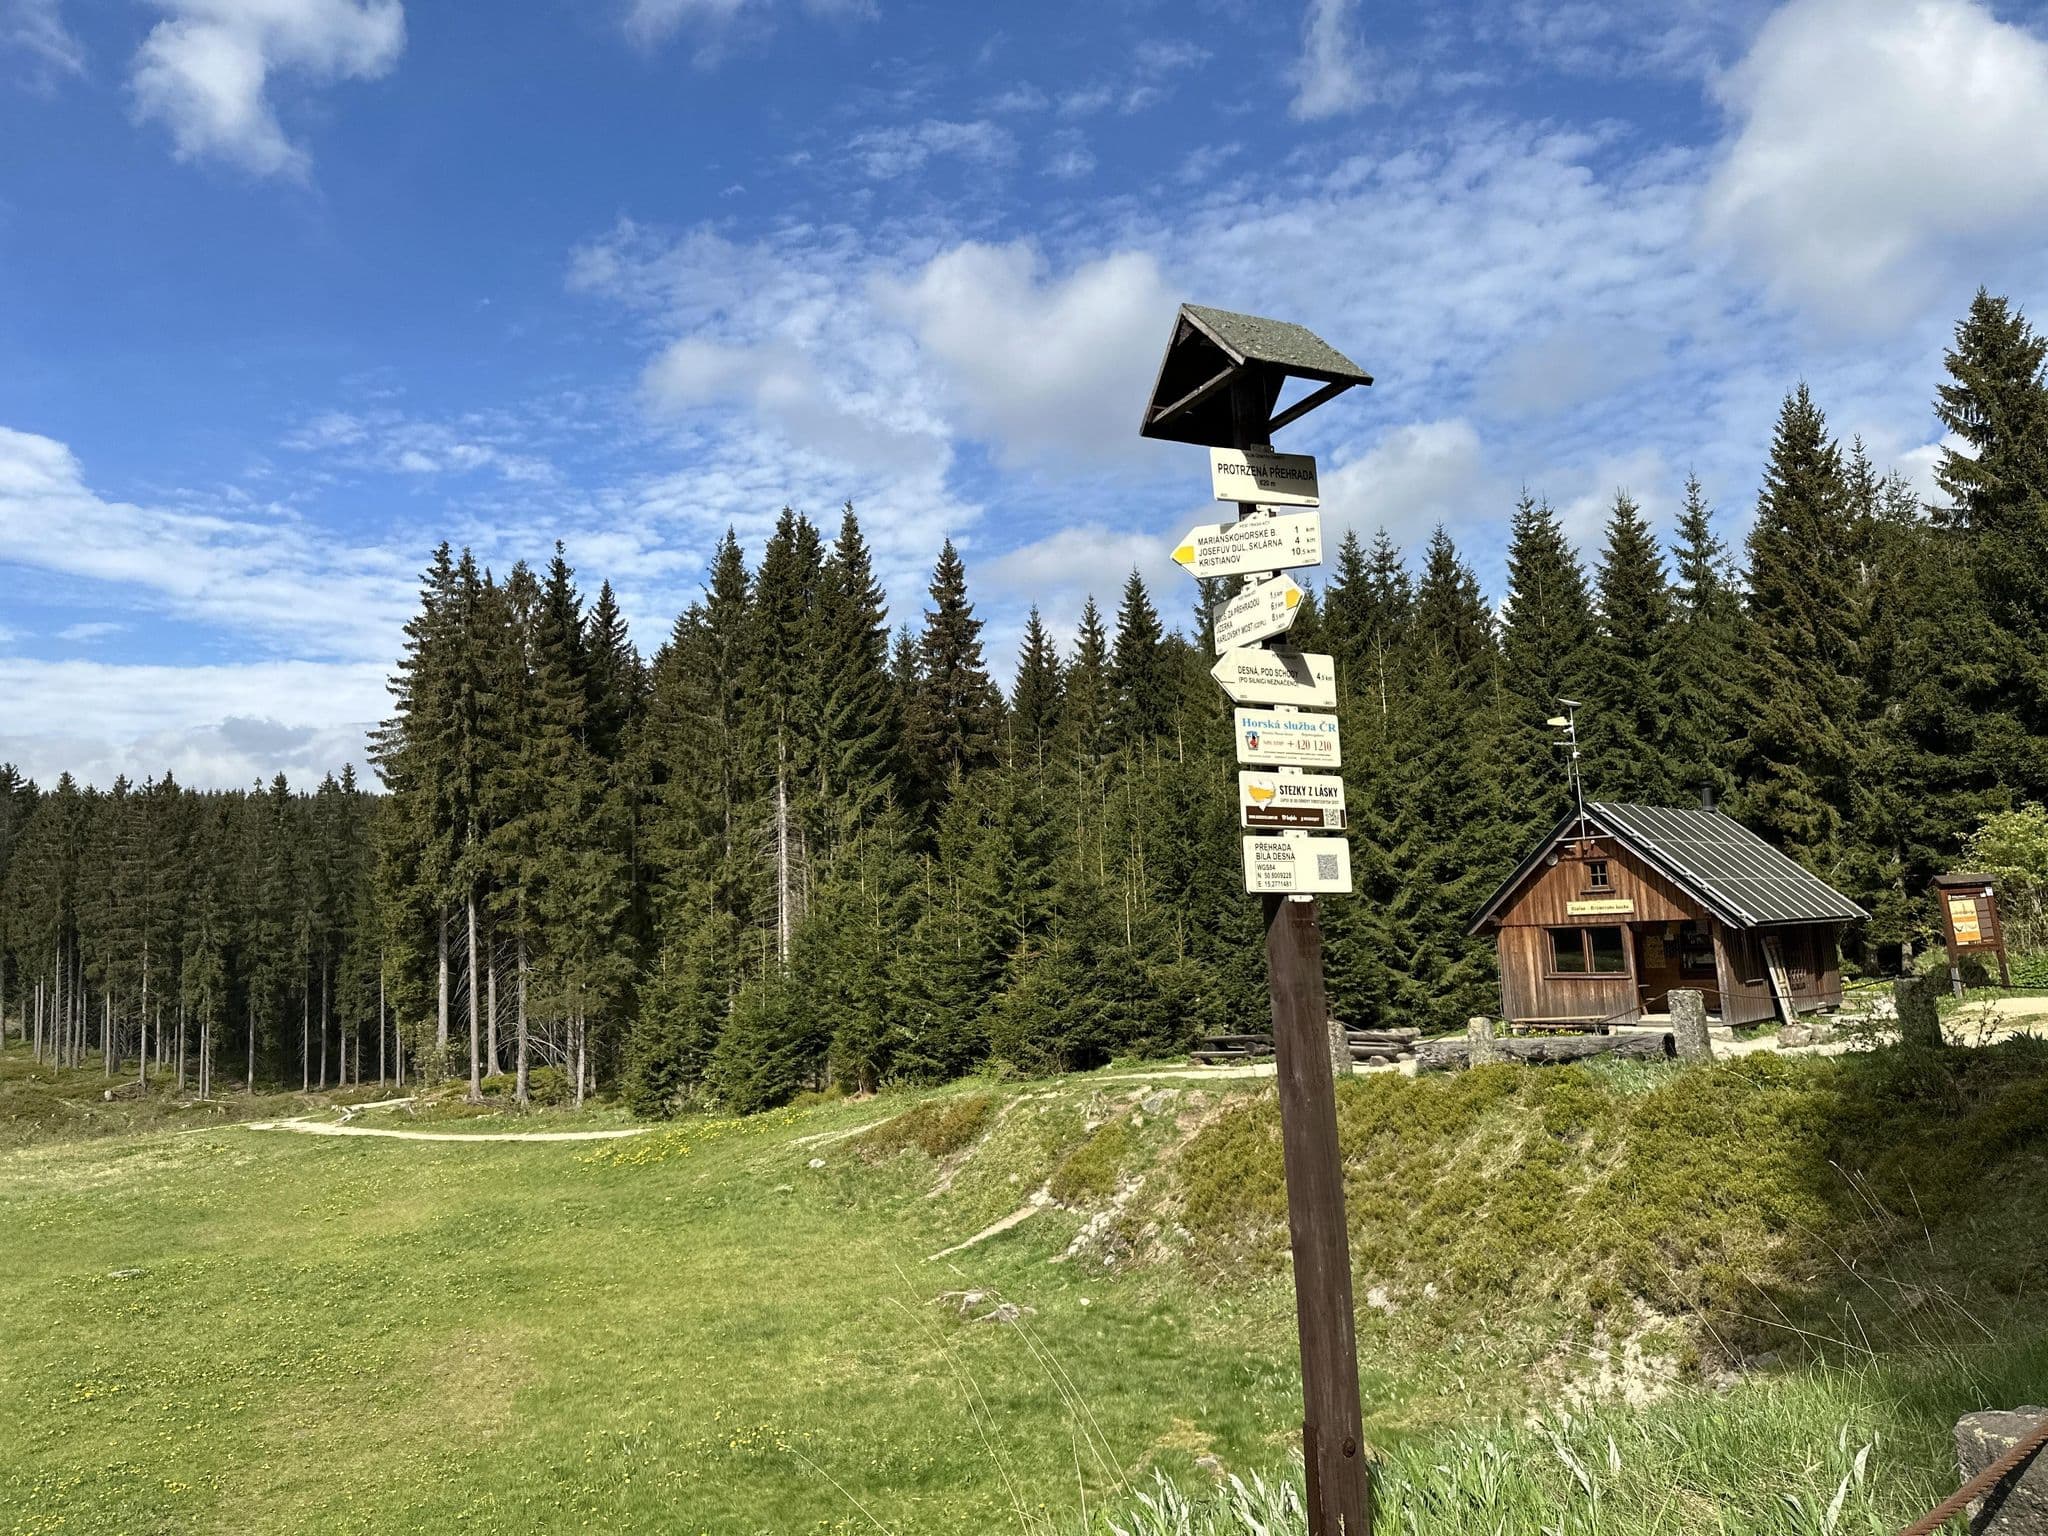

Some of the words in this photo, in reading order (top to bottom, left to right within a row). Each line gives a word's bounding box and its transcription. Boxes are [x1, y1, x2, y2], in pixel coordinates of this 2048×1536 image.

[1270, 465, 1314, 480] PŘEHRADA
[1294, 536, 1300, 544] 4
[1199, 555, 1241, 567] KRISTIANOV
[1260, 667, 1274, 677] POD
[1242, 718, 1281, 729] Horská
[1283, 720, 1316, 731] služba
[1319, 721, 1337, 733] ČR
[1279, 785, 1306, 796] STEZKY
[1308, 786, 1313, 796] Z
[1314, 784, 1338, 798] LÁSKY
